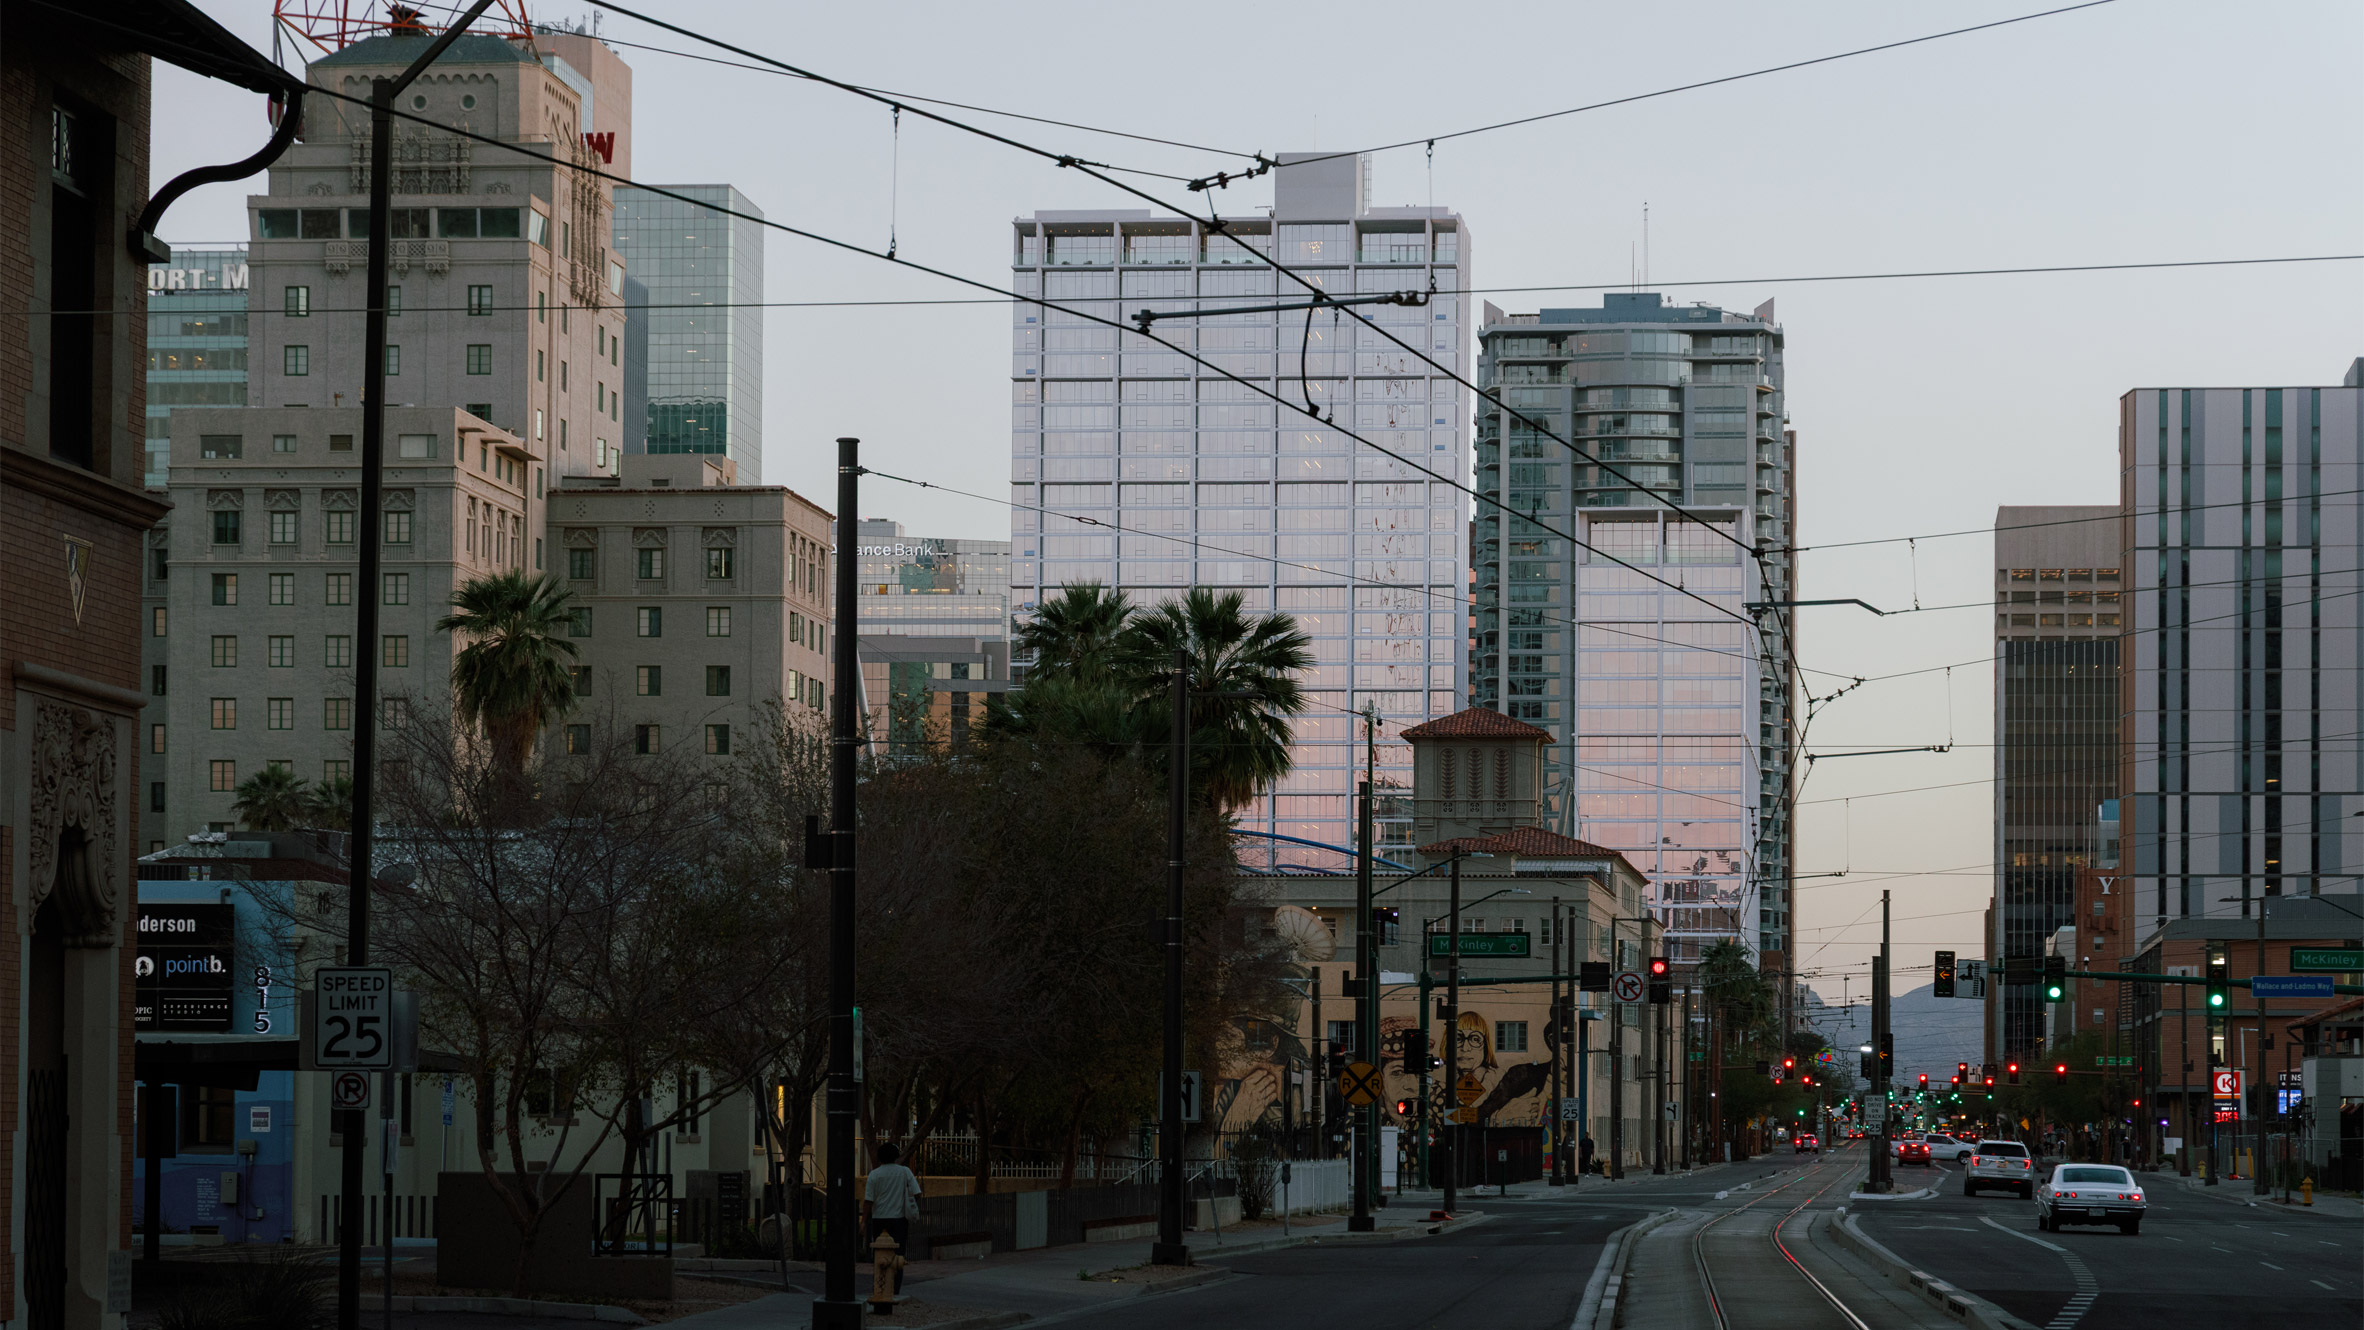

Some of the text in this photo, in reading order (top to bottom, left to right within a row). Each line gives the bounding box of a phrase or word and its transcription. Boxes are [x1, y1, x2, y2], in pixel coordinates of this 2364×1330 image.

[895, 543, 932, 556] Bank
[1440, 940, 1494, 952] MKinley
[2301, 954, 2357, 967] McKinley
[323, 976, 385, 992] SPEED
[2256, 982, 2279, 990] Wallace
[254, 966, 271, 1033] 815
[329, 996, 378, 1010] LIMIT
[323, 1015, 382, 1058] 25
[1342, 1078, 1380, 1090] R R
[1563, 1108, 1578, 1119] 25
[1869, 1123, 1881, 1133] 25
